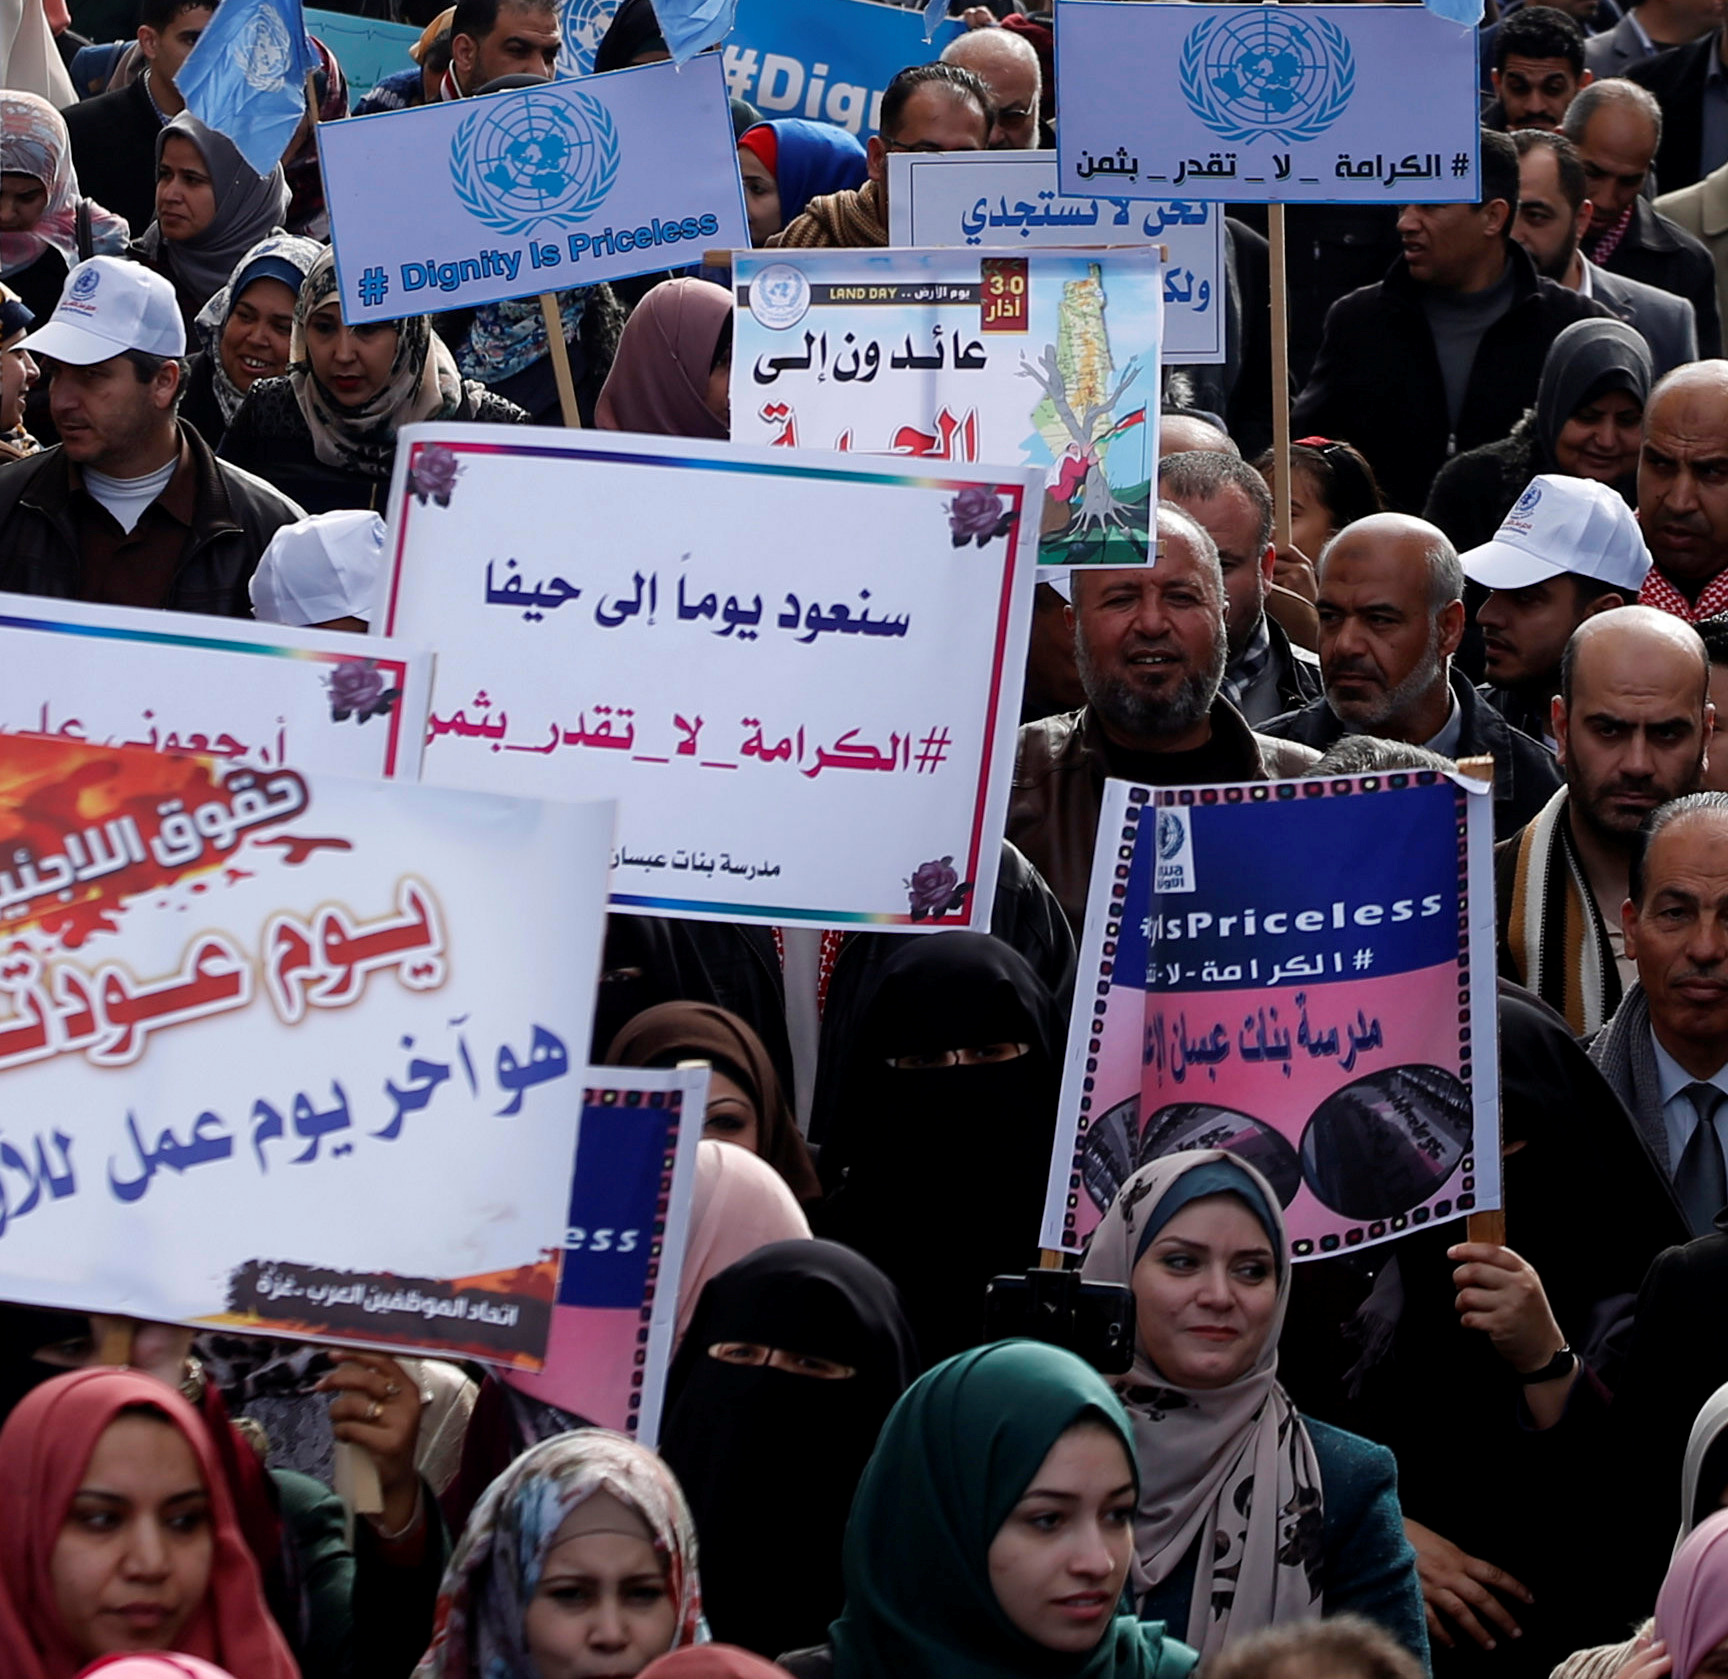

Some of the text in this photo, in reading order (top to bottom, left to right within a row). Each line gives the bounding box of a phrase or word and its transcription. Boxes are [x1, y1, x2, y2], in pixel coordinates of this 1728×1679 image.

[725, 43, 884, 134] #Dig
[1076, 146, 1139, 181] بثمن
[1173, 152, 1238, 185] تقدر
[1273, 154, 1292, 181] لا
[1335, 153, 1443, 187] الكرامة
[357, 212, 720, 307] # Dignity Is Priceless
[829, 287, 866, 300] LAND
[869, 287, 898, 300] DAY
[950, 290, 971, 300] يوم
[1162, 266, 1211, 313] ولك
[752, 323, 989, 388] عائدون إلى
[484, 557, 582, 622] حيفا
[593, 570, 658, 627] إلى
[777, 586, 911, 643] سنعود
[150, 768, 308, 876] حقوق
[671, 849, 715, 876] بنات
[717, 854, 782, 880] مدرسة
[270, 876, 447, 1022] يوم
[1238, 1005, 1293, 1078] بنات
[1297, 992, 1384, 1071] مدرسة
[369, 1014, 479, 1143] آخر
[493, 1022, 570, 1116] هو
[252, 1076, 354, 1176] يوم
[105, 1108, 235, 1204] عمل
[562, 1226, 640, 1253] ess
[306, 1281, 366, 1307] العرب
[363, 1286, 467, 1320] الموظفين
[466, 1298, 520, 1327] اتحاد
